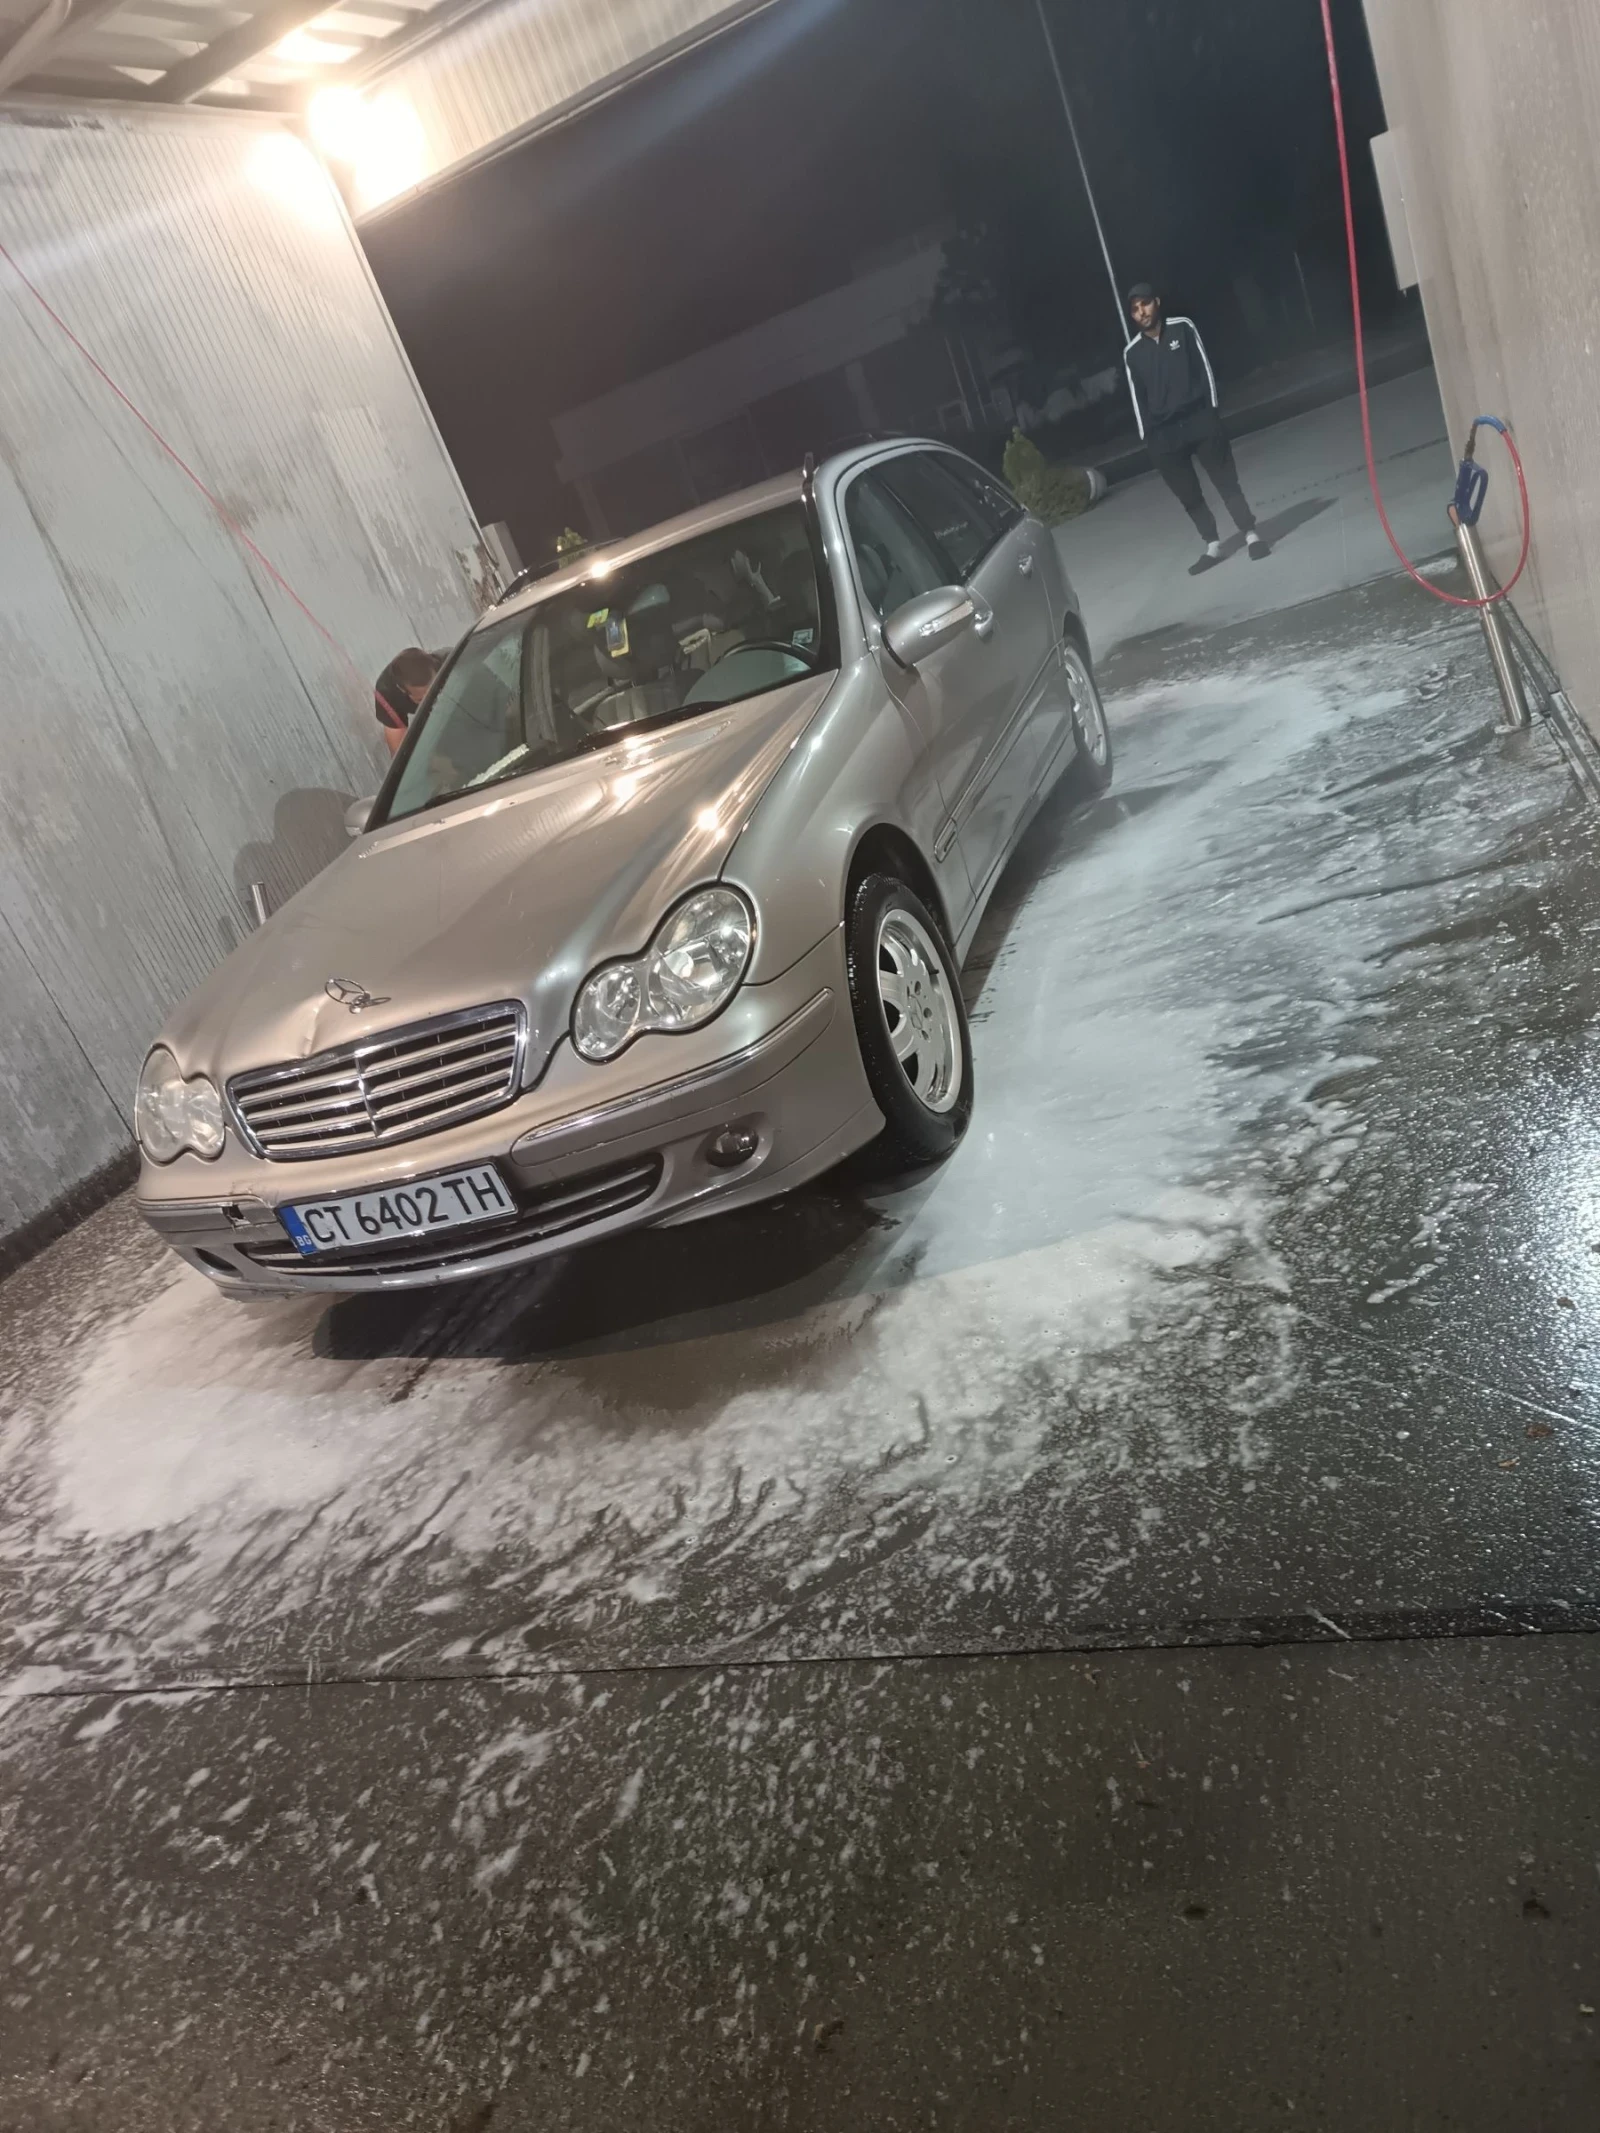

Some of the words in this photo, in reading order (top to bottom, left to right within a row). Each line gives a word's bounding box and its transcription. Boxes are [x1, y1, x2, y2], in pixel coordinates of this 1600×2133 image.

[304, 1206, 350, 1243] CT
[355, 1187, 449, 1235] 6402
[441, 1172, 505, 1215] TH
[295, 1234, 312, 1247] BG
